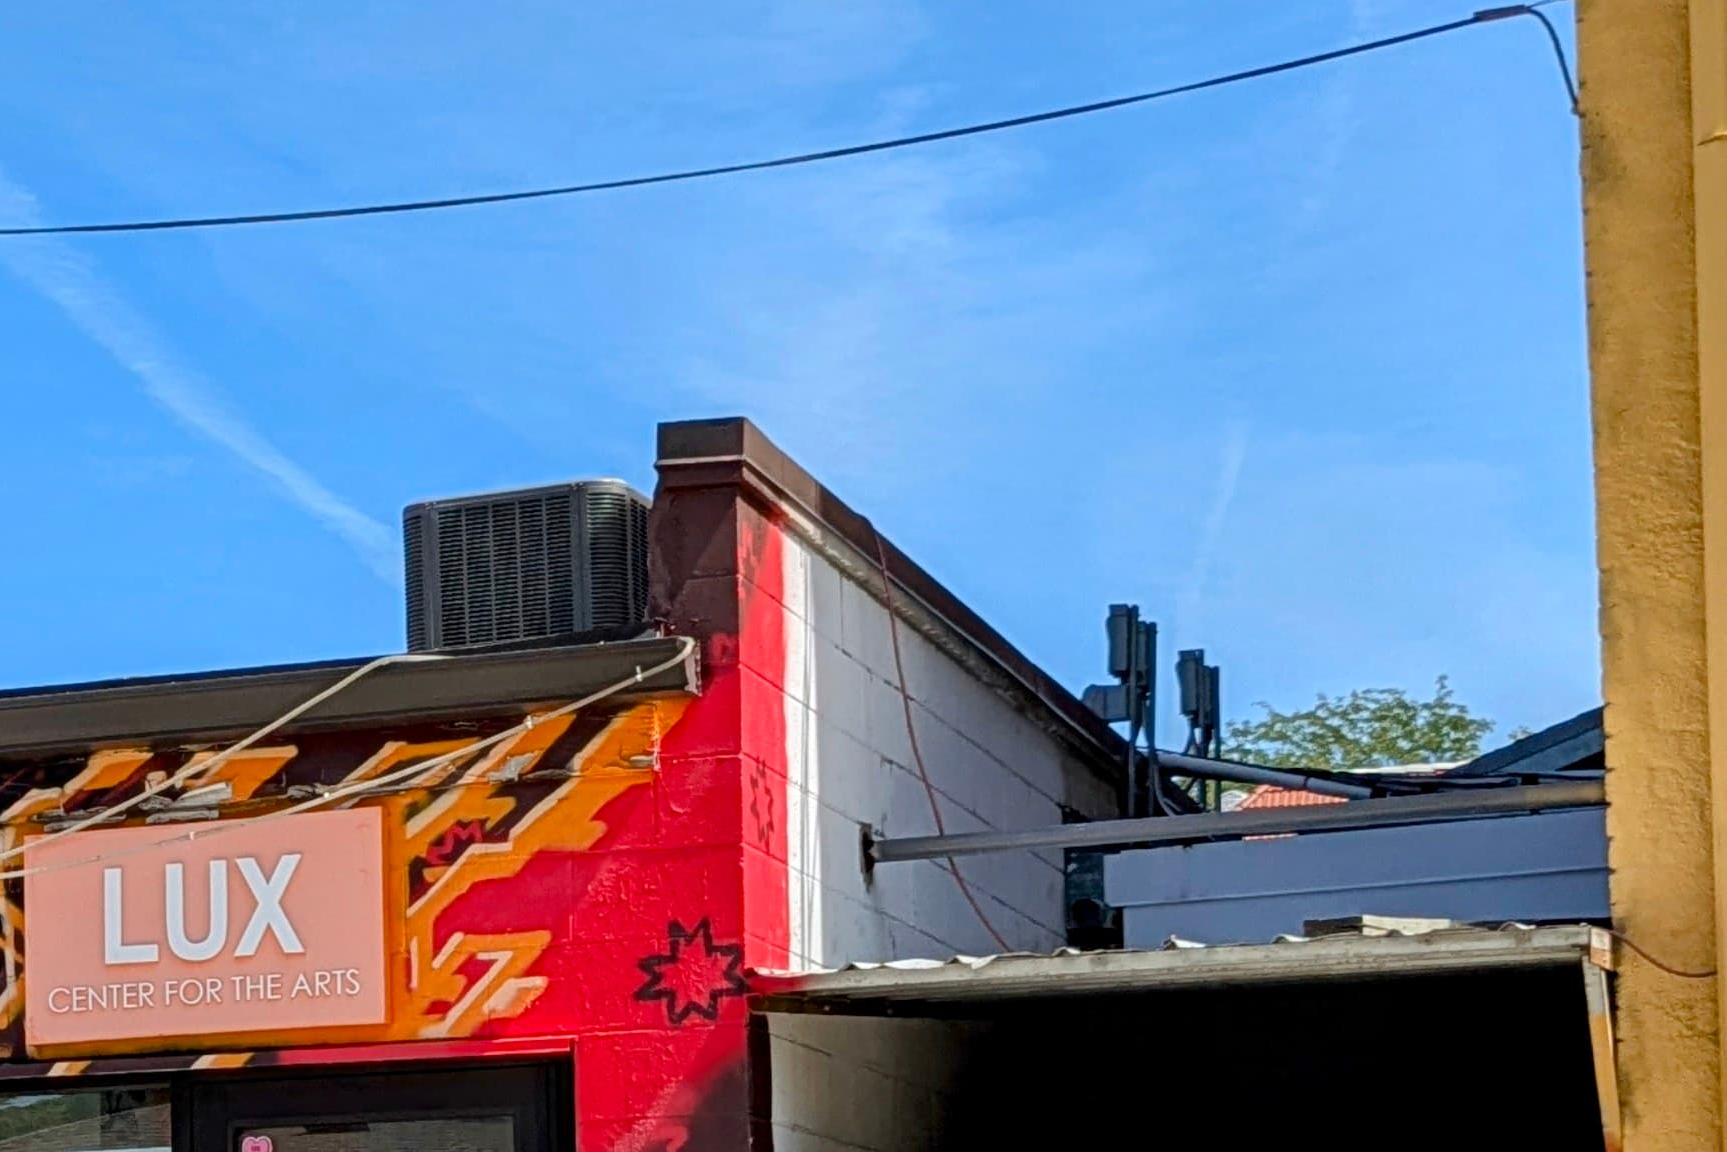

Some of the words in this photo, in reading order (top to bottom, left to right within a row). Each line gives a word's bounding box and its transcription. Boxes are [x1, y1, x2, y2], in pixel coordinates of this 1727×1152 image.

[104, 853, 306, 965] LUX
[48, 982, 154, 1014] CENTER
[165, 978, 223, 1006] FOR
[231, 974, 282, 1001] THE
[291, 968, 361, 998] ARTS
